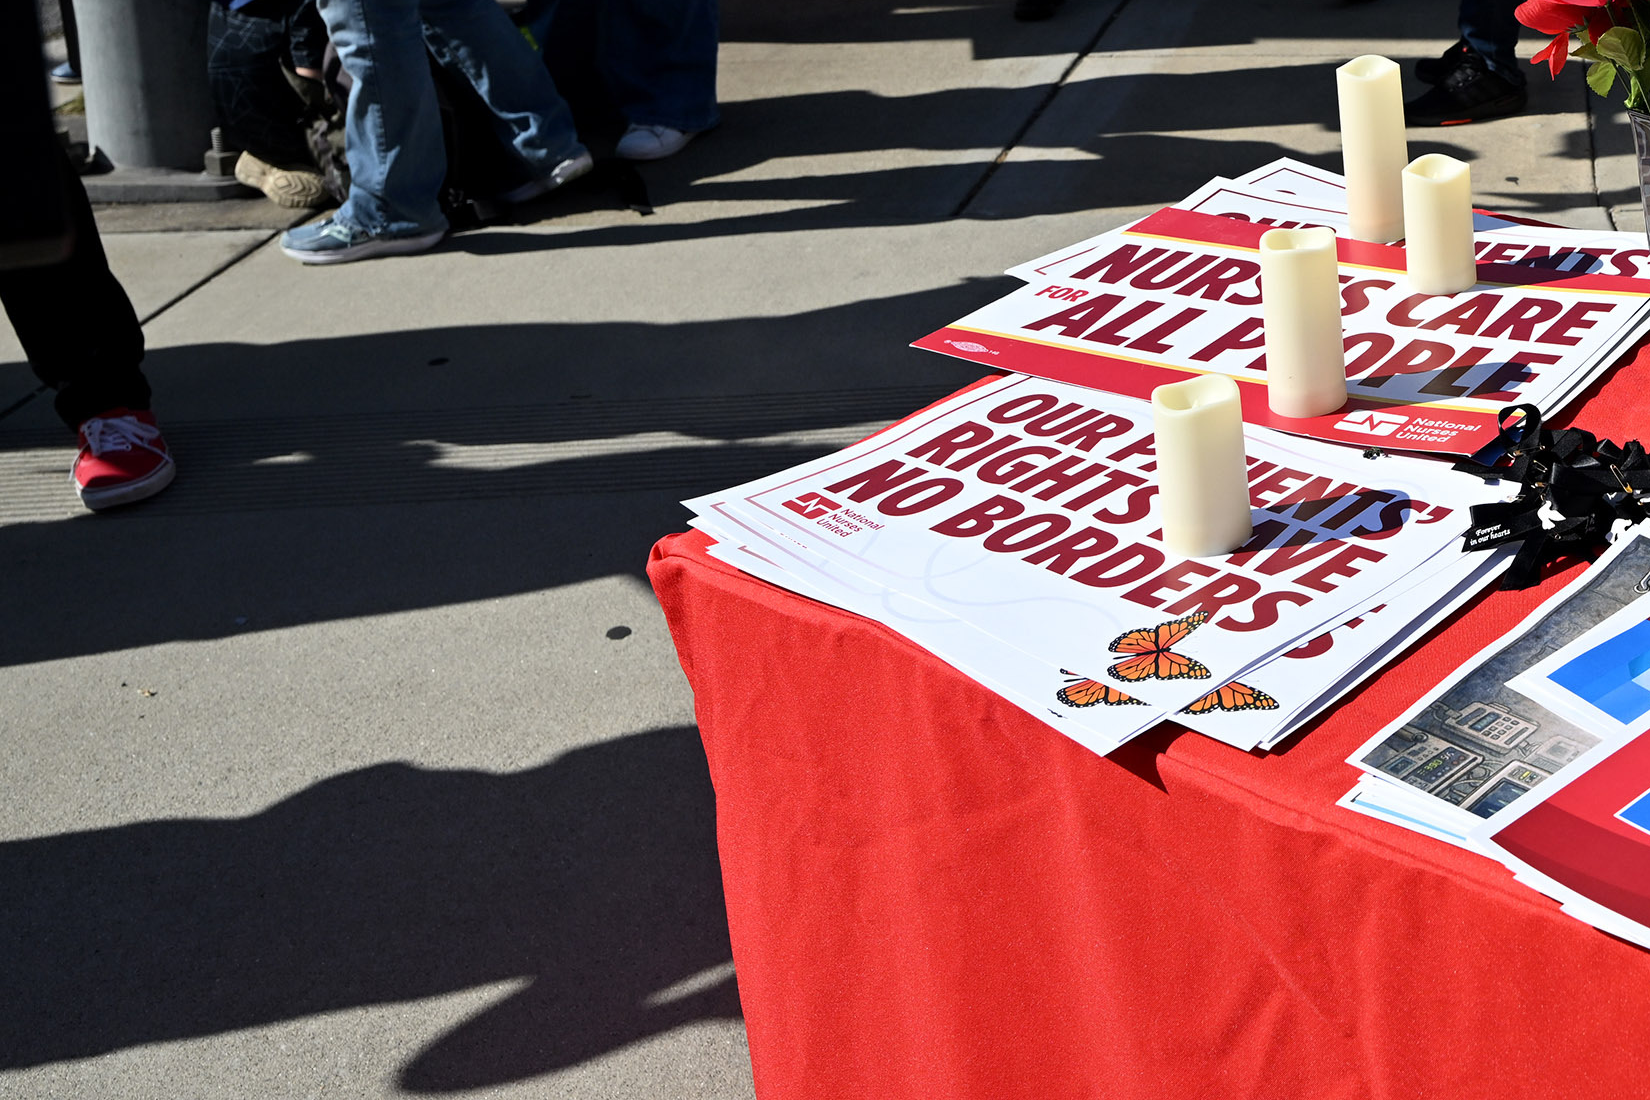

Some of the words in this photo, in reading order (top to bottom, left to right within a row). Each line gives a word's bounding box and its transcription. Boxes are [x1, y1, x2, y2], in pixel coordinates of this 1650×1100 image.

[1034, 283, 1090, 304] FOR
[1386, 292, 1615, 346] CARE
[1020, 293, 1208, 355] ALL
[1193, 316, 1563, 403] POPLE
[986, 393, 1135, 452] OUR
[1403, 425, 1459, 437] Nurses
[1413, 417, 1481, 432] National
[1396, 431, 1450, 443] United
[905, 420, 1159, 525] RIGHTS
[1147, 518, 1388, 594] AVE
[816, 518, 852, 538] United
[828, 513, 863, 532] Nurses
[840, 508, 885, 531] National
[1470, 537, 1478, 546] in
[1477, 534, 1490, 545] our
[1490, 527, 1511, 542] hearts
[1475, 523, 1501, 537] Forever
[823, 458, 965, 517] NO
[929, 494, 1313, 632] BORDERS
